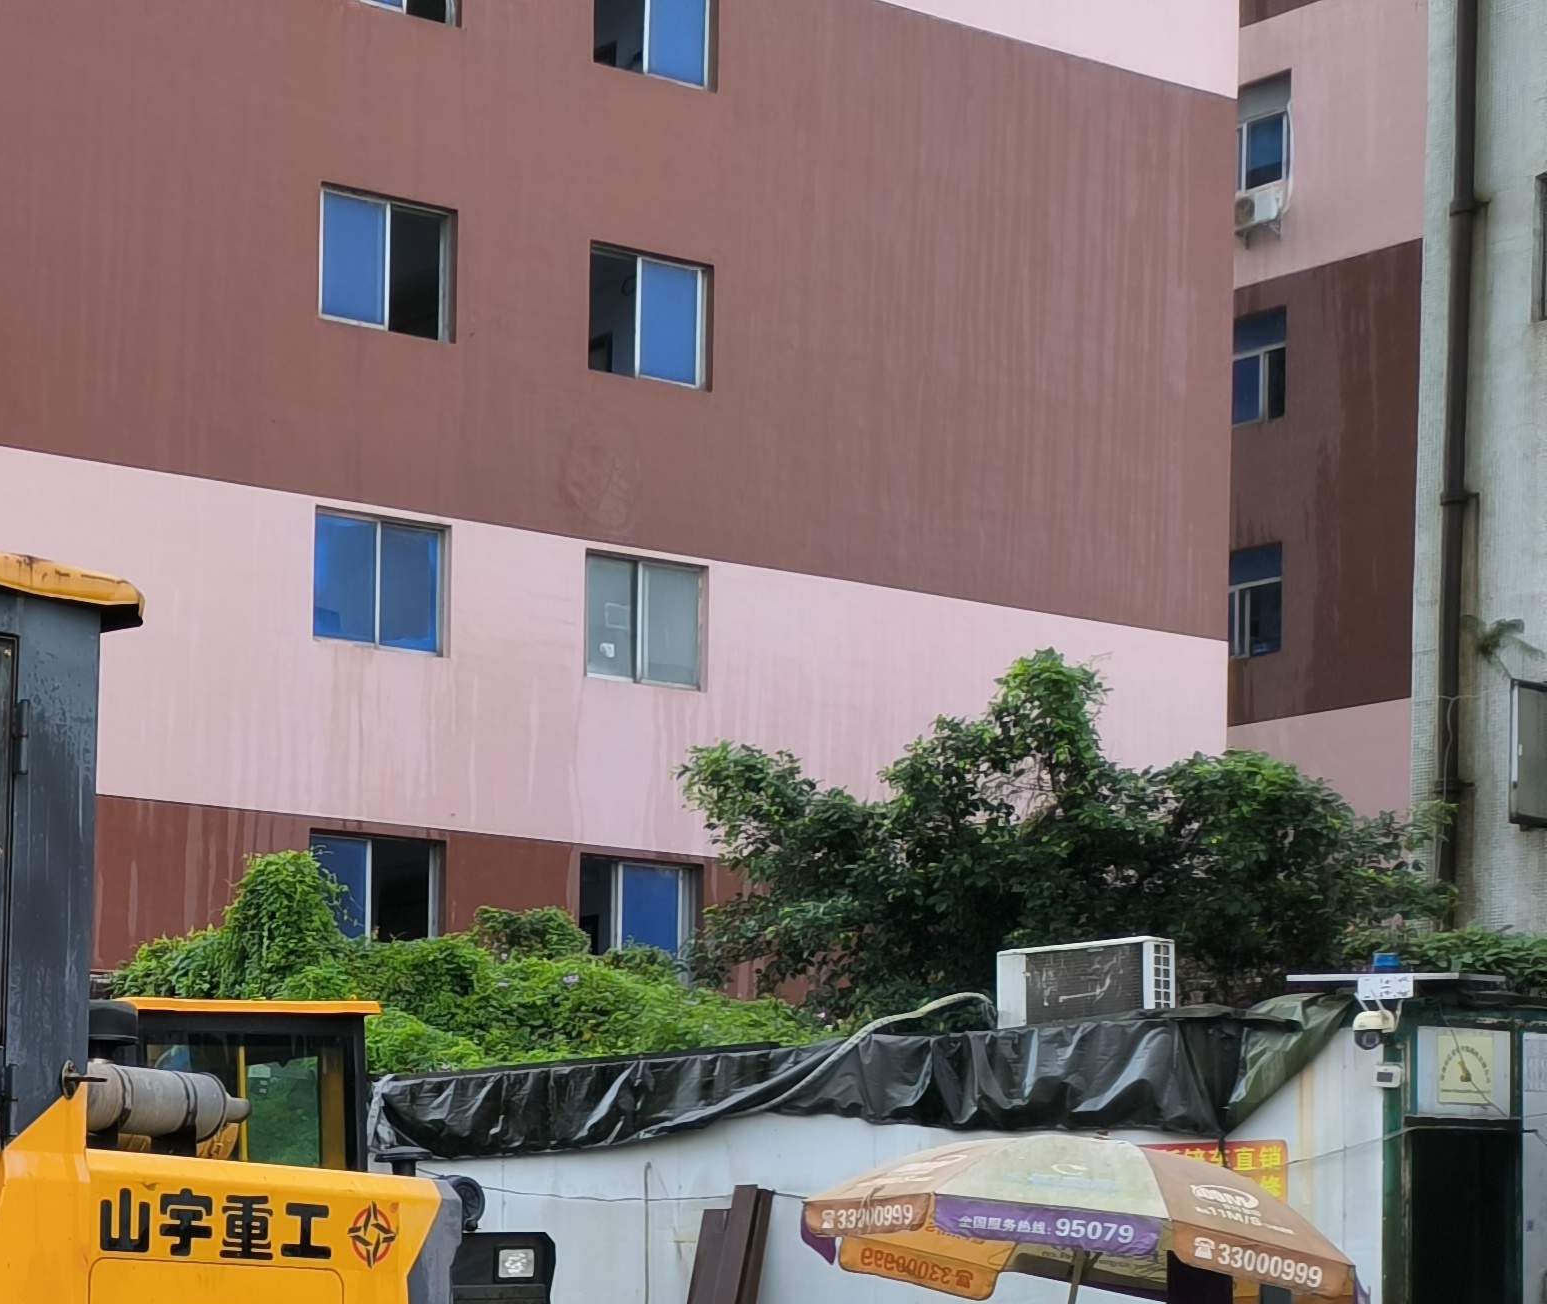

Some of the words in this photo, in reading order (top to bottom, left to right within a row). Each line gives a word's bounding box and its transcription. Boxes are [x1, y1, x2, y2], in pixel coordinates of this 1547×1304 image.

[100, 1188, 332, 1260] 山宇重工
[1055, 1218, 1135, 1243] 95079
[1218, 1244, 1322, 1288] 33000999
